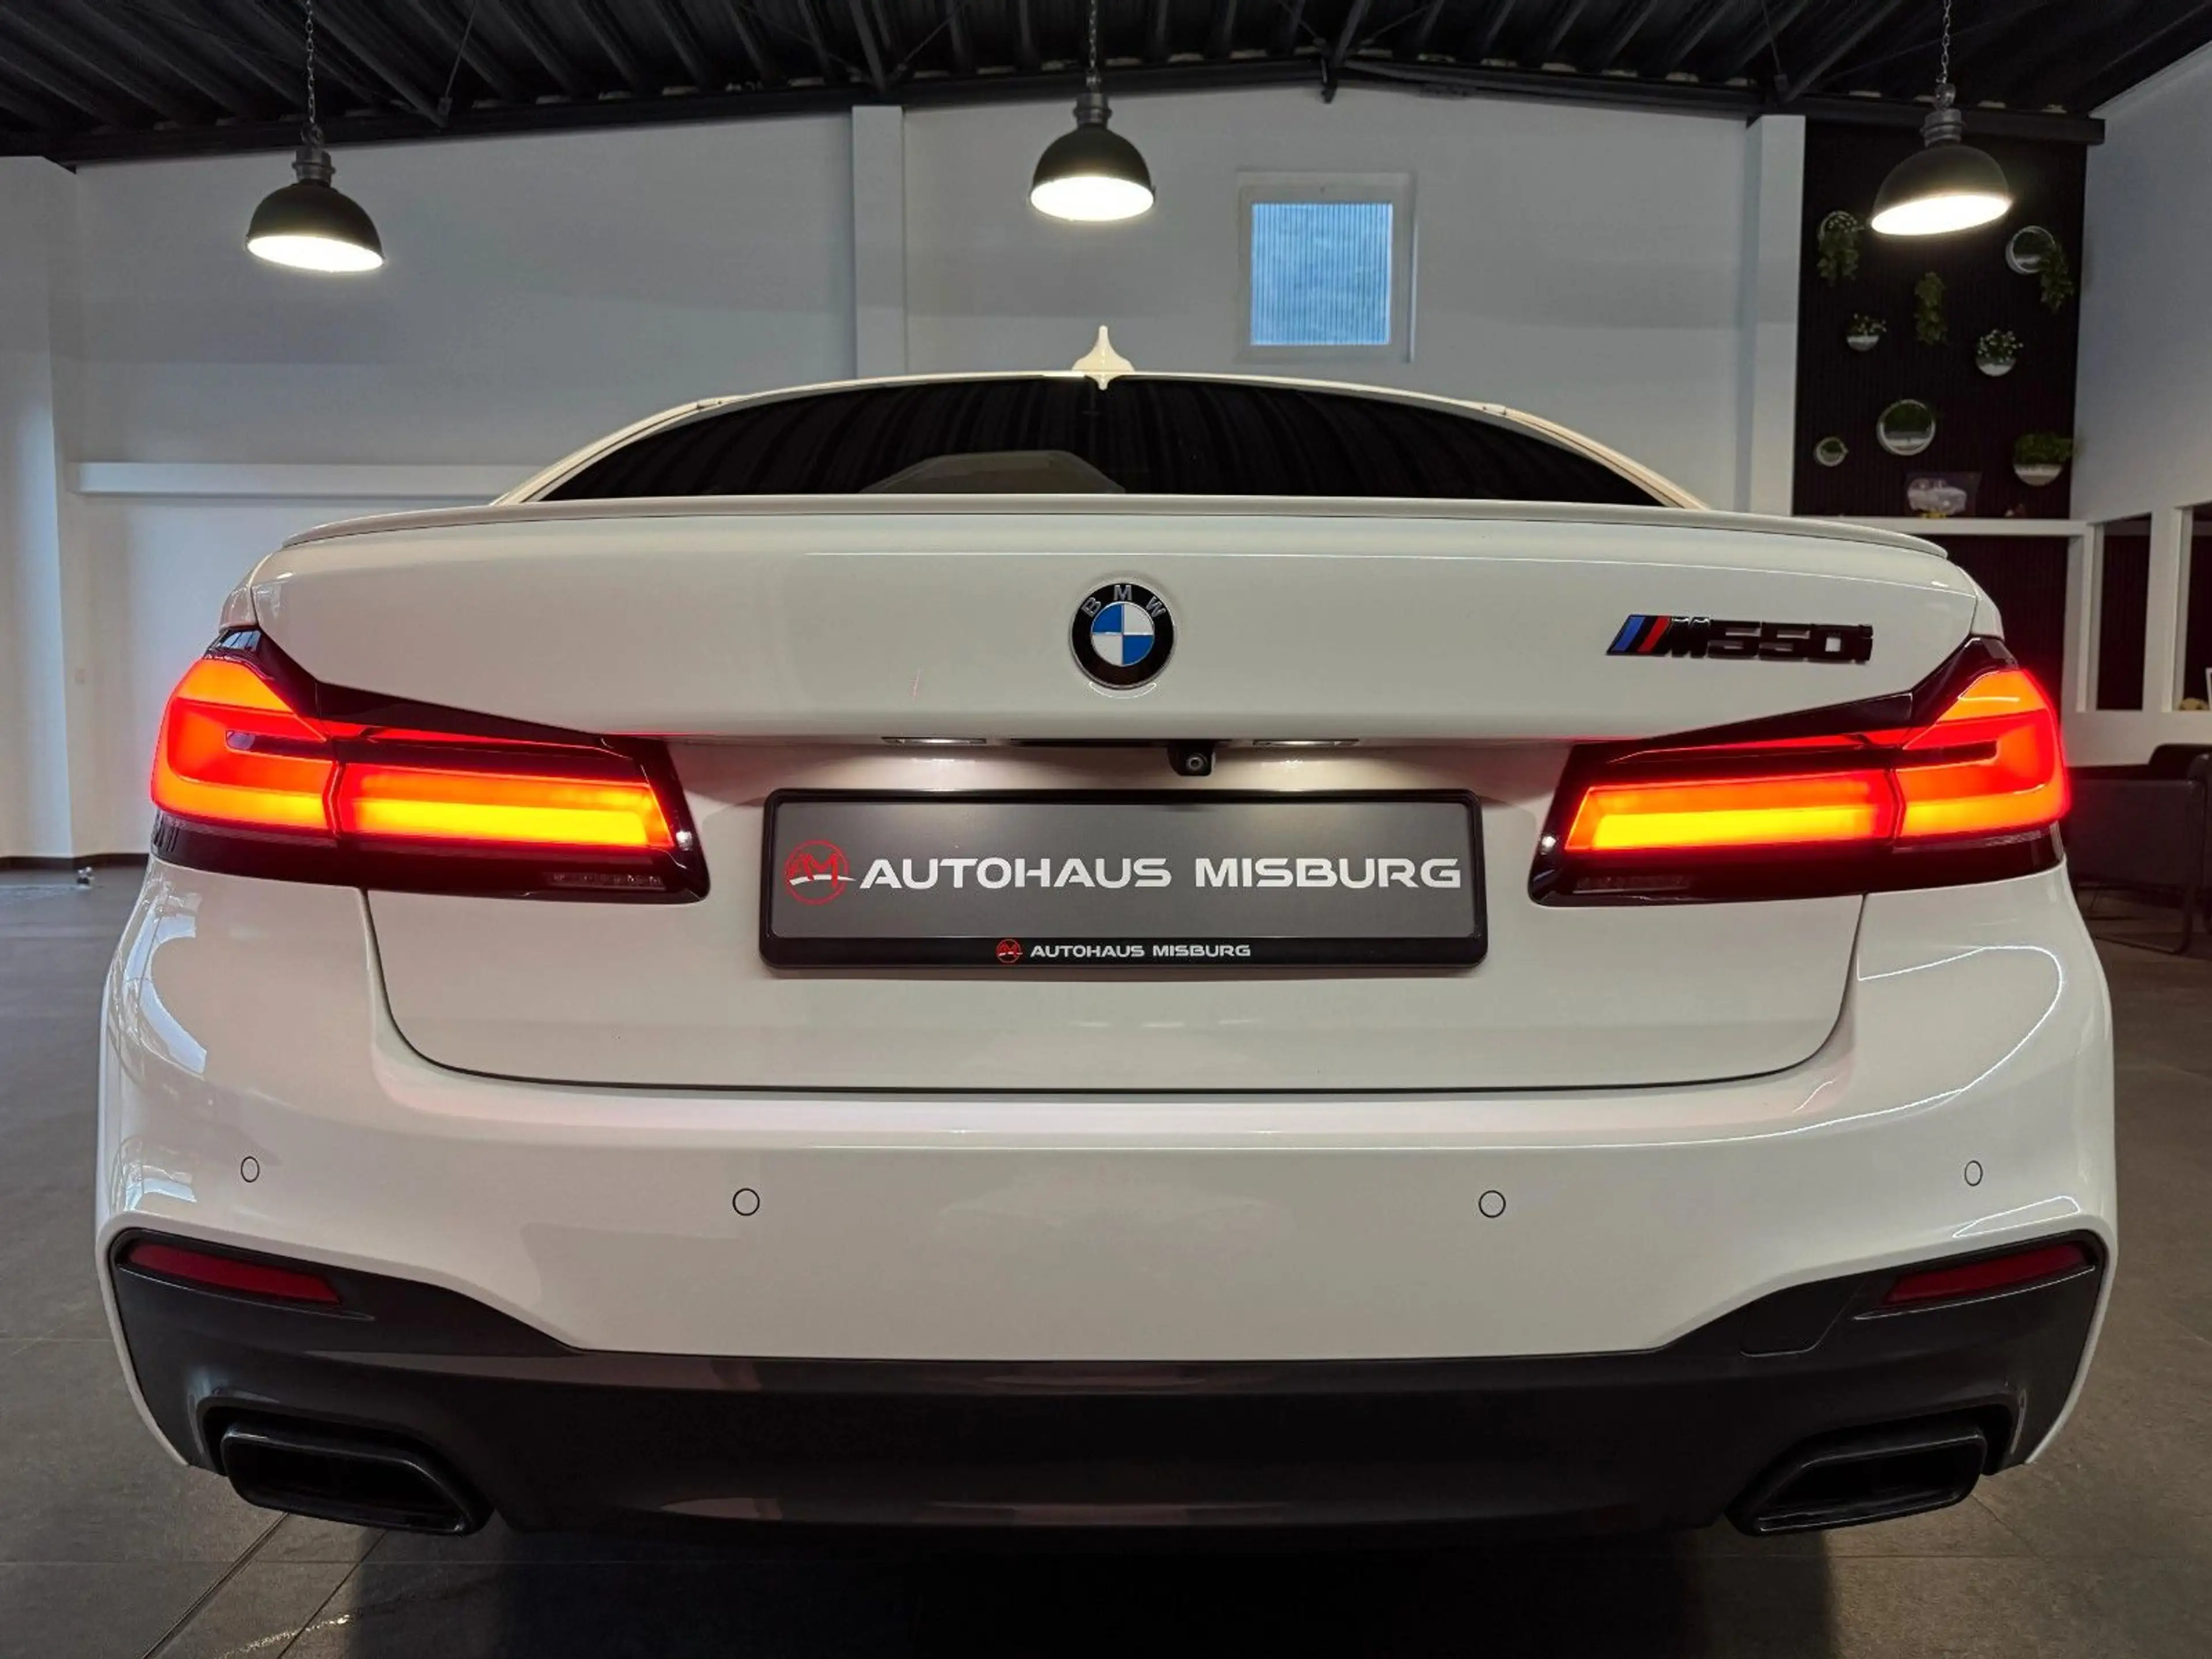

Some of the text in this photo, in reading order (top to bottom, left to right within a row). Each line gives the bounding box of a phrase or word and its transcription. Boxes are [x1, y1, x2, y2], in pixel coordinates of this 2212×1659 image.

[1081, 584, 1167, 618] BMW
[859, 857, 1172, 889] AUTOHAUS
[1195, 857, 1461, 889] MISBURG
[1030, 945, 1145, 957] AUTOHAUS
[1152, 945, 1251, 957] MISBURG
